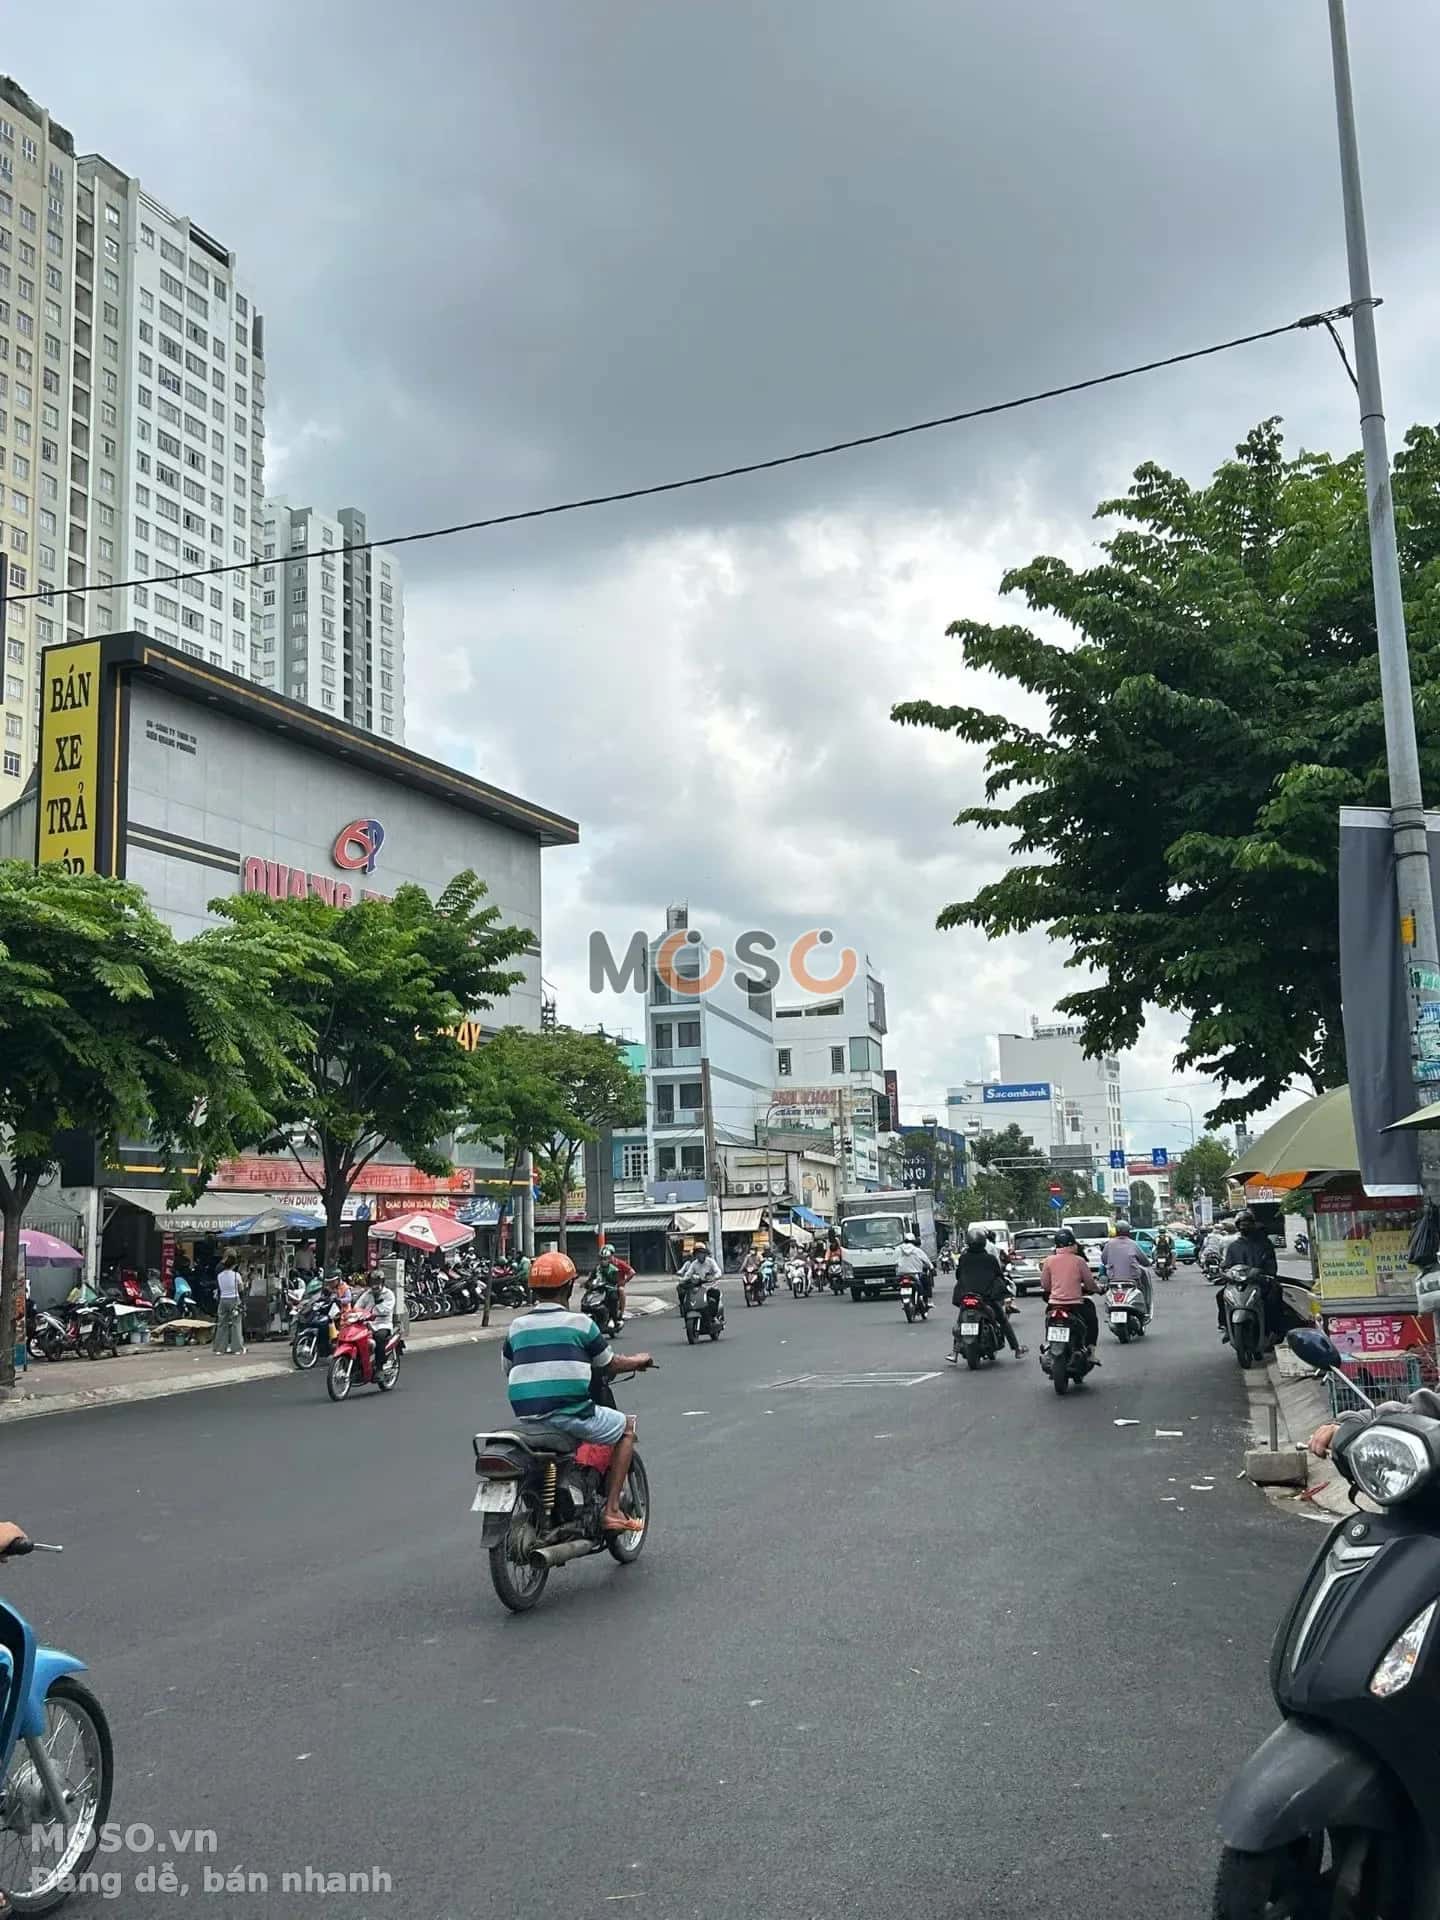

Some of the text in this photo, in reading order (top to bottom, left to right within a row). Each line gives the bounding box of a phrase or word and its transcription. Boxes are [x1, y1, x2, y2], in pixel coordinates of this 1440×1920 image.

[50, 663, 92, 713] BÁN
[54, 734, 83, 773] XE
[46, 781, 88, 835] TRẢ
[985, 1087, 1048, 1100] Sacombank
